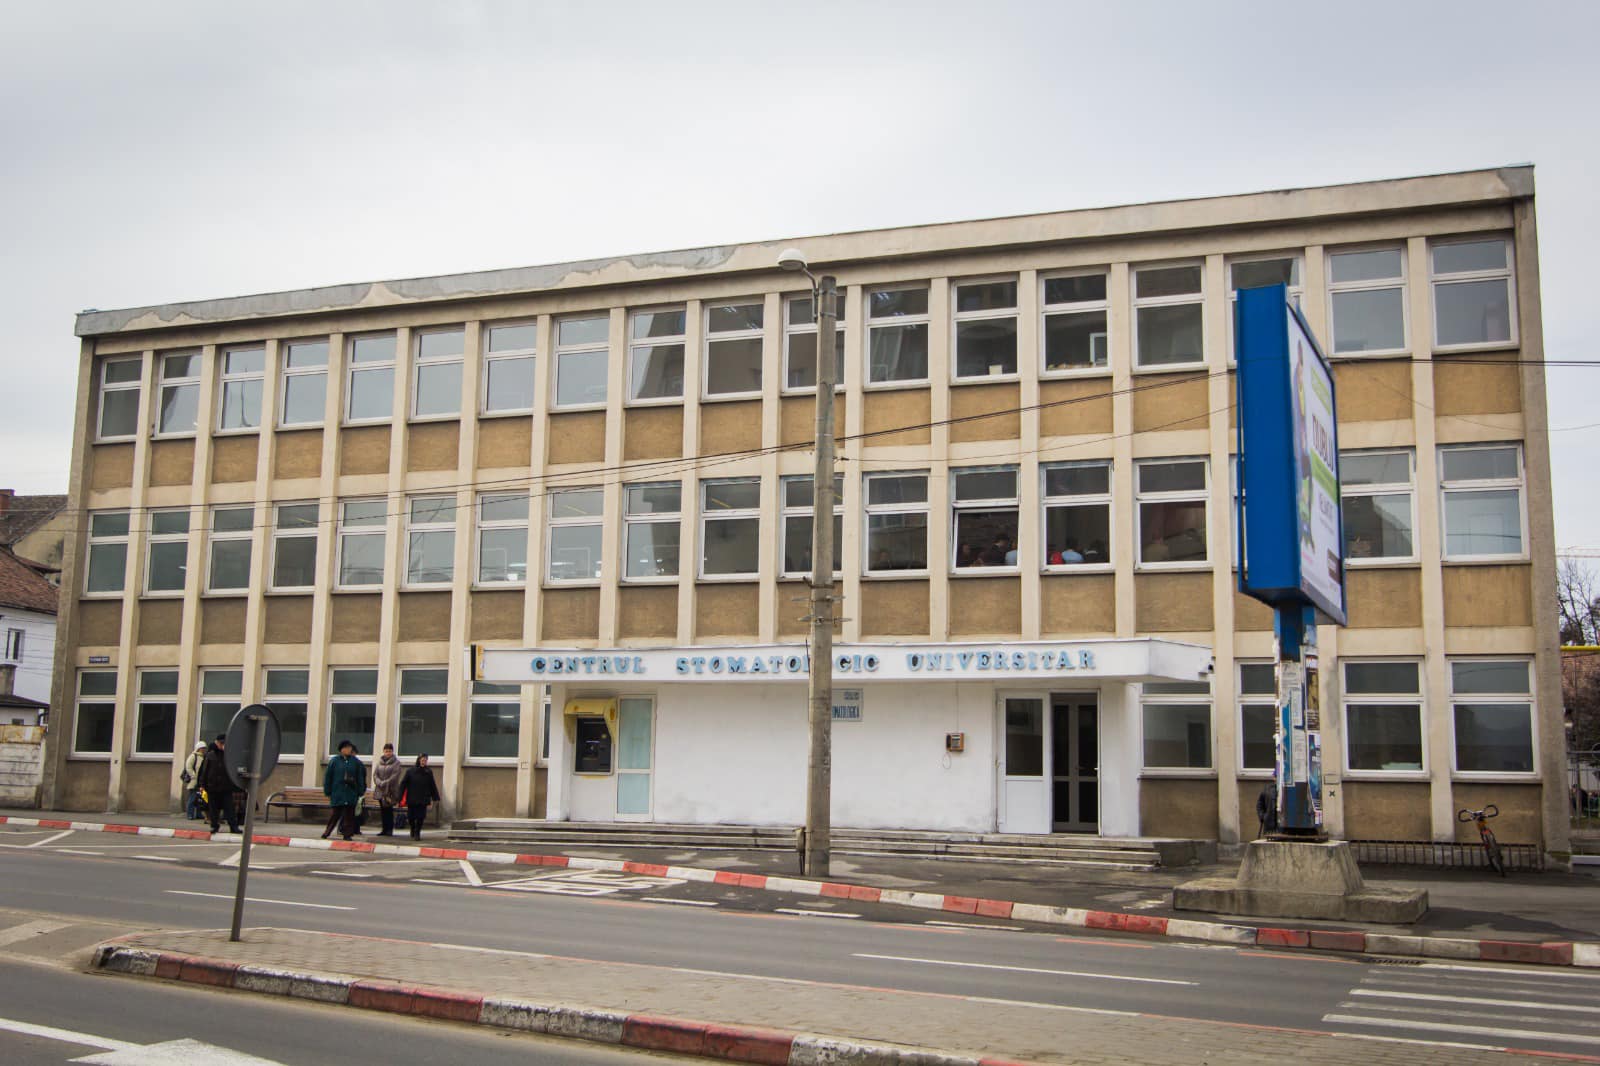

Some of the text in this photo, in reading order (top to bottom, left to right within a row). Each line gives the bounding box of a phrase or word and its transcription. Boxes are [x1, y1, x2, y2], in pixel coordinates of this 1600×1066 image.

[531, 650, 1096, 673] CENTRUL STOMATOGIC UNIVERSITAR
[487, 873, 687, 896] BUS
